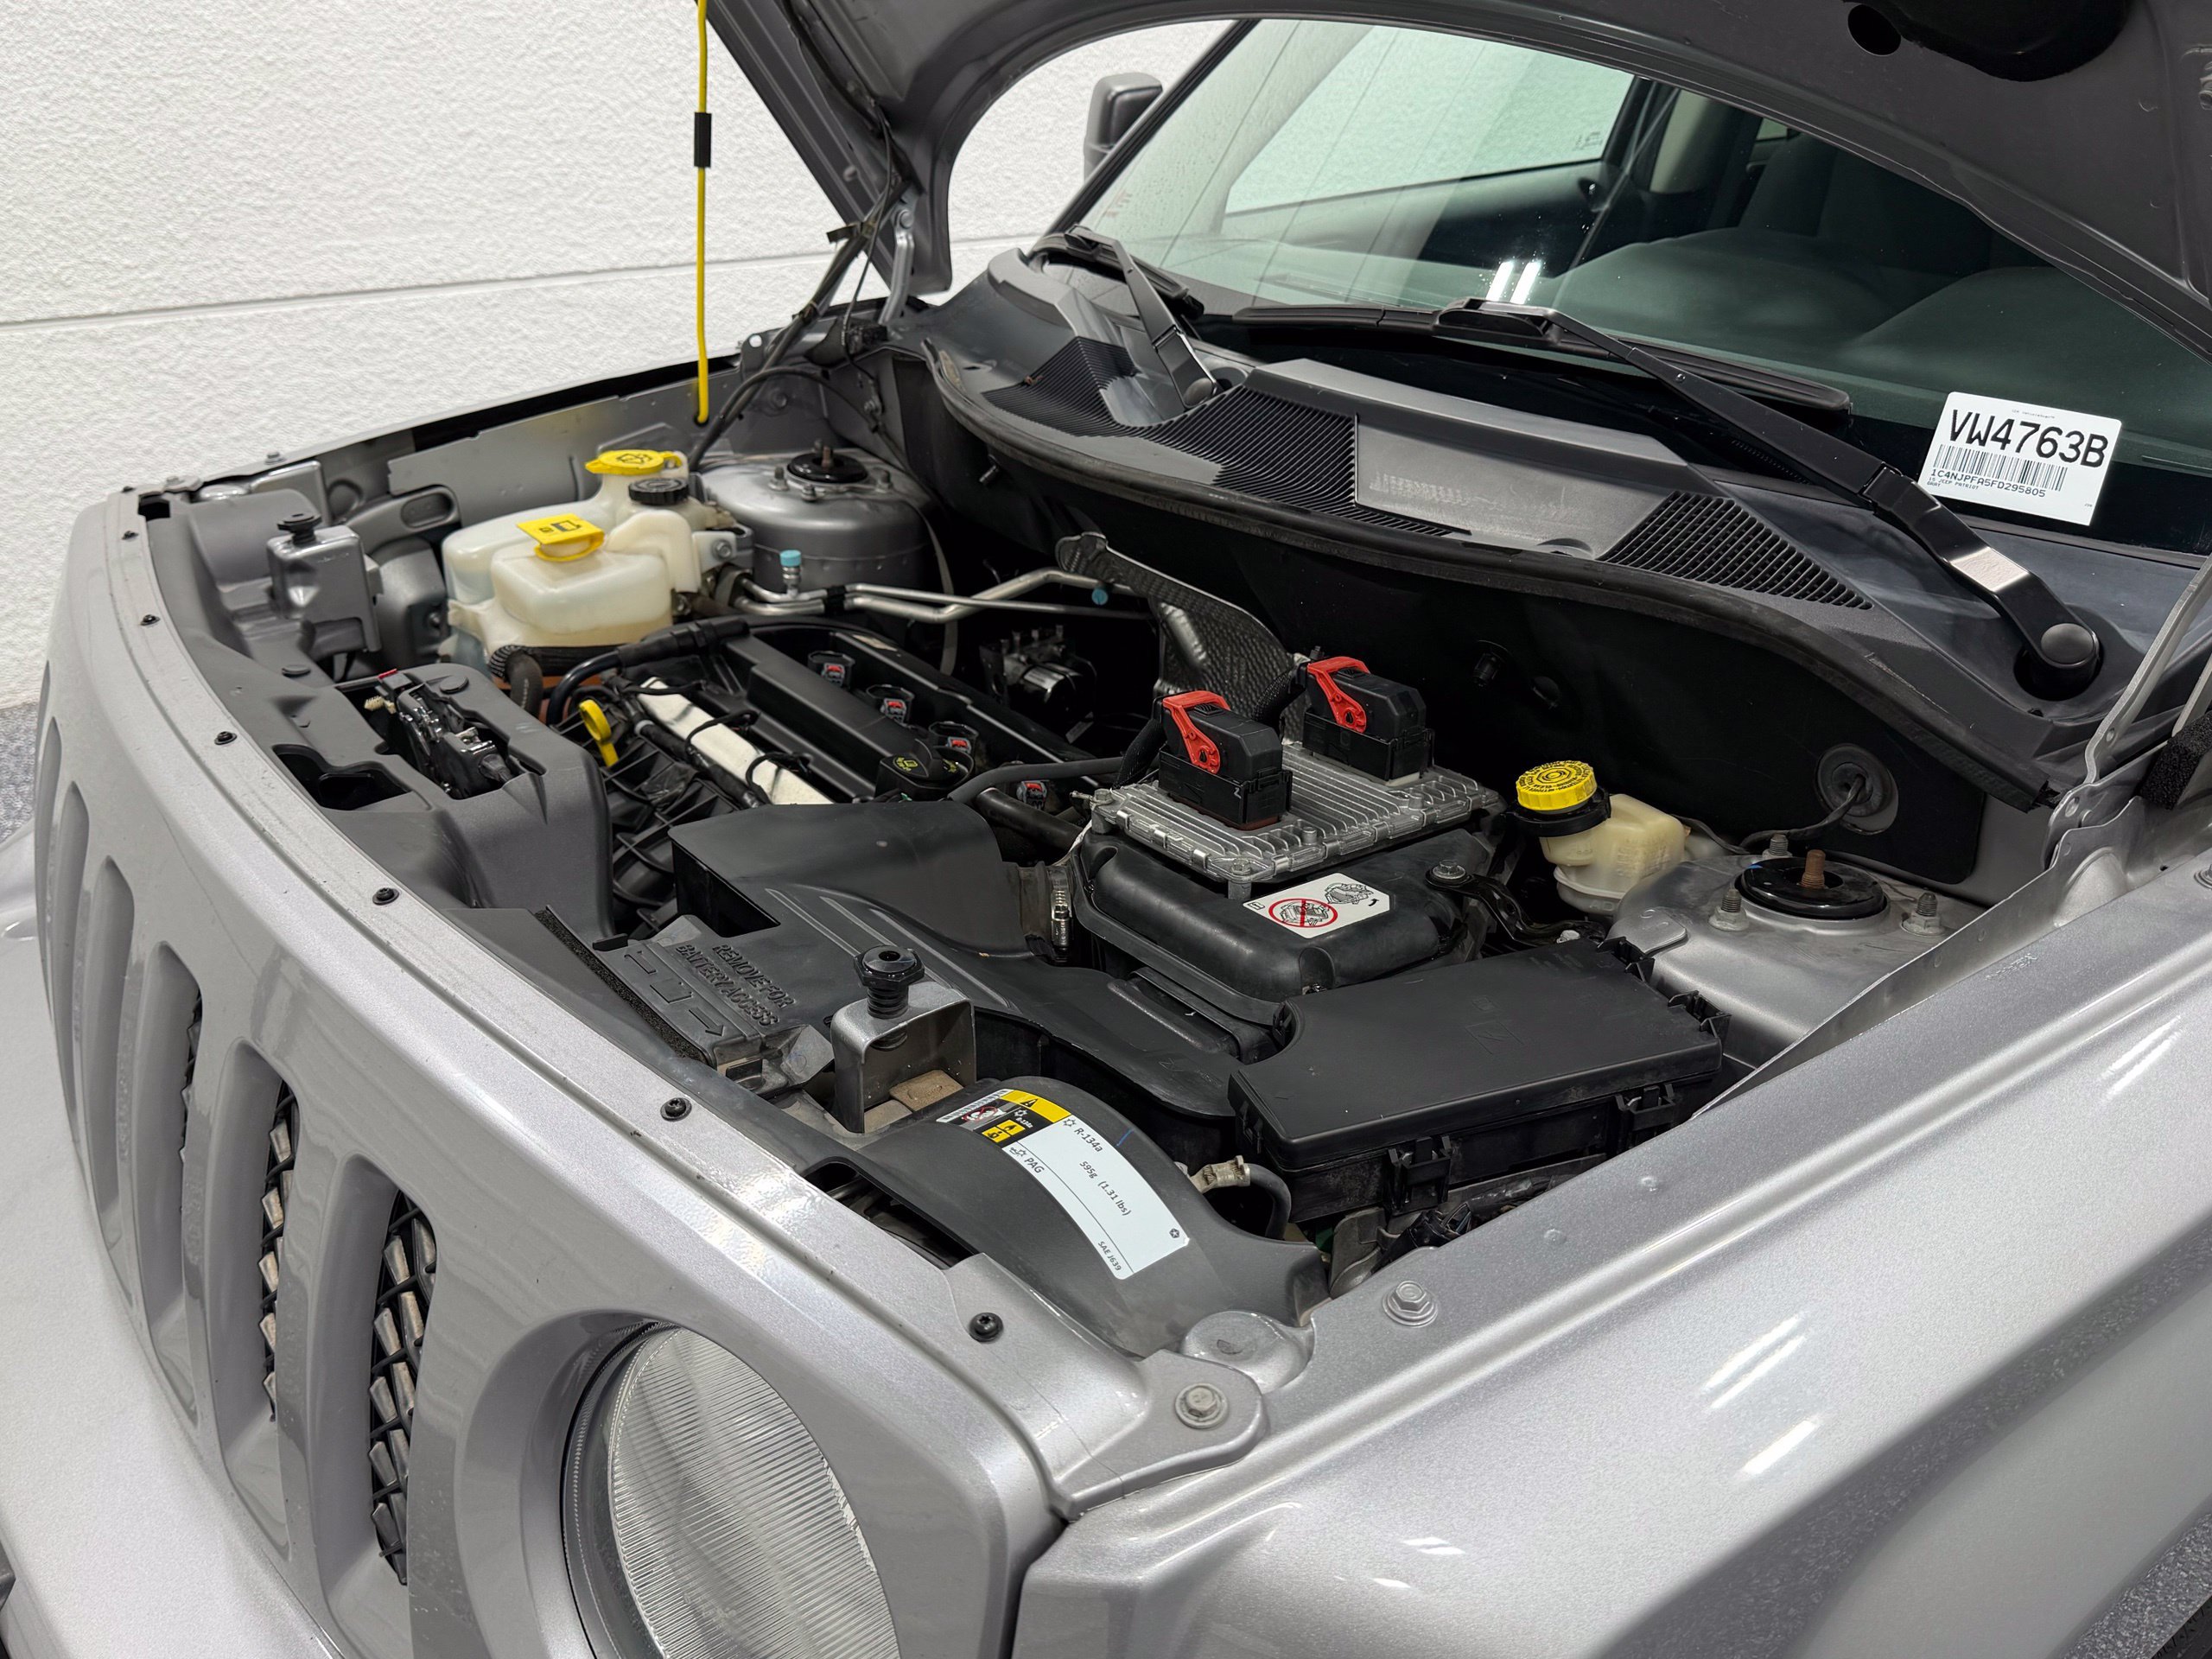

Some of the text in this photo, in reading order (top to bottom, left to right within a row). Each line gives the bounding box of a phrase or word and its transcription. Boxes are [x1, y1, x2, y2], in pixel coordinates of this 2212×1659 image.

[1949, 410, 2108, 467] VW4763B
[1930, 468, 2046, 497] 1C4NJPFA5FD295805
[1955, 481, 1980, 490] PATRIOT
[676, 944, 779, 1026] BATTERY ACCESS
[711, 944, 796, 1008] REMOVE FOR
[1074, 1127, 1103, 1153] R-134a
[1024, 1156, 1045, 1174] PAG
[1079, 1160, 1132, 1217] 595g (1.31 lbs)
[1097, 1241, 1122, 1271] SAE J639
